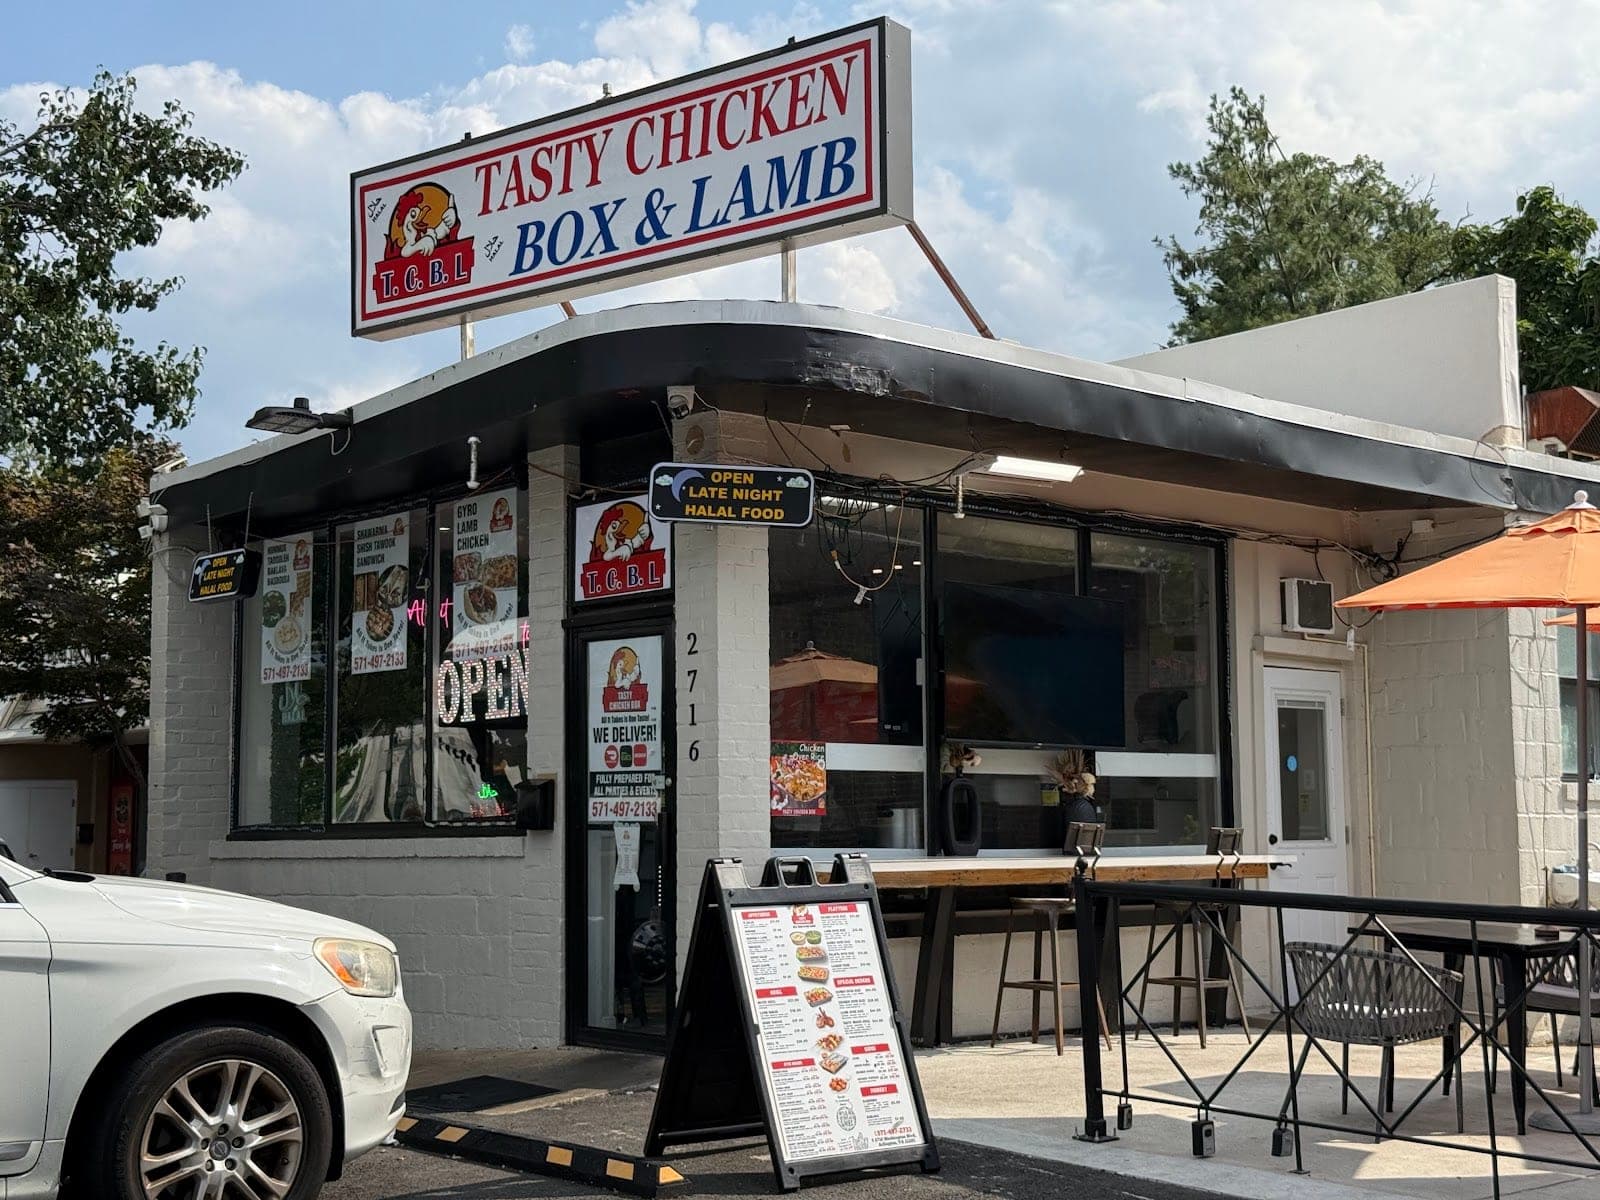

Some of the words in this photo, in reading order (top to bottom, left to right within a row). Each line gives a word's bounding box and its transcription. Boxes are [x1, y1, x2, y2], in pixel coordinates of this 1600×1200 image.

[475, 129, 614, 217] TASTY
[626, 55, 858, 176] CHICKEN
[372, 203, 387, 223] HALAL
[509, 198, 627, 276] BOX
[635, 188, 677, 246] &
[683, 136, 856, 234] LAMB
[489, 240, 504, 262] HALAL
[711, 471, 754, 485] OPEN
[688, 486, 728, 499] LATE
[732, 488, 783, 502] NIGHT
[457, 502, 478, 519] GYRO
[685, 504, 736, 518] HALAL
[741, 507, 785, 520] FOOD
[457, 519, 478, 535] LAMB
[457, 533, 490, 551] CHICKEN
[212, 557, 228, 568] OPEN
[203, 569, 217, 581] LATE
[217, 566, 235, 578] NIGHT
[199, 583, 216, 596] HALAL
[217, 581, 233, 592] FOOD
[354, 652, 404, 671] 571-497-2133
[263, 663, 308, 681] 571-497-2133
[438, 647, 529, 724] OPEN
[617, 691, 632, 700] TASTY
[593, 727, 609, 744] WE
[613, 724, 657, 743] DELIVER!
[799, 744, 825, 752] Chicken
[792, 752, 809, 761] Over
[811, 752, 825, 761] Rice
[596, 774, 612, 785] FULLY
[613, 773, 643, 784] PREPARED
[594, 786, 603, 796] ALL
[635, 785, 658, 797] EVENTS
[592, 801, 658, 817] 571-497-2133
